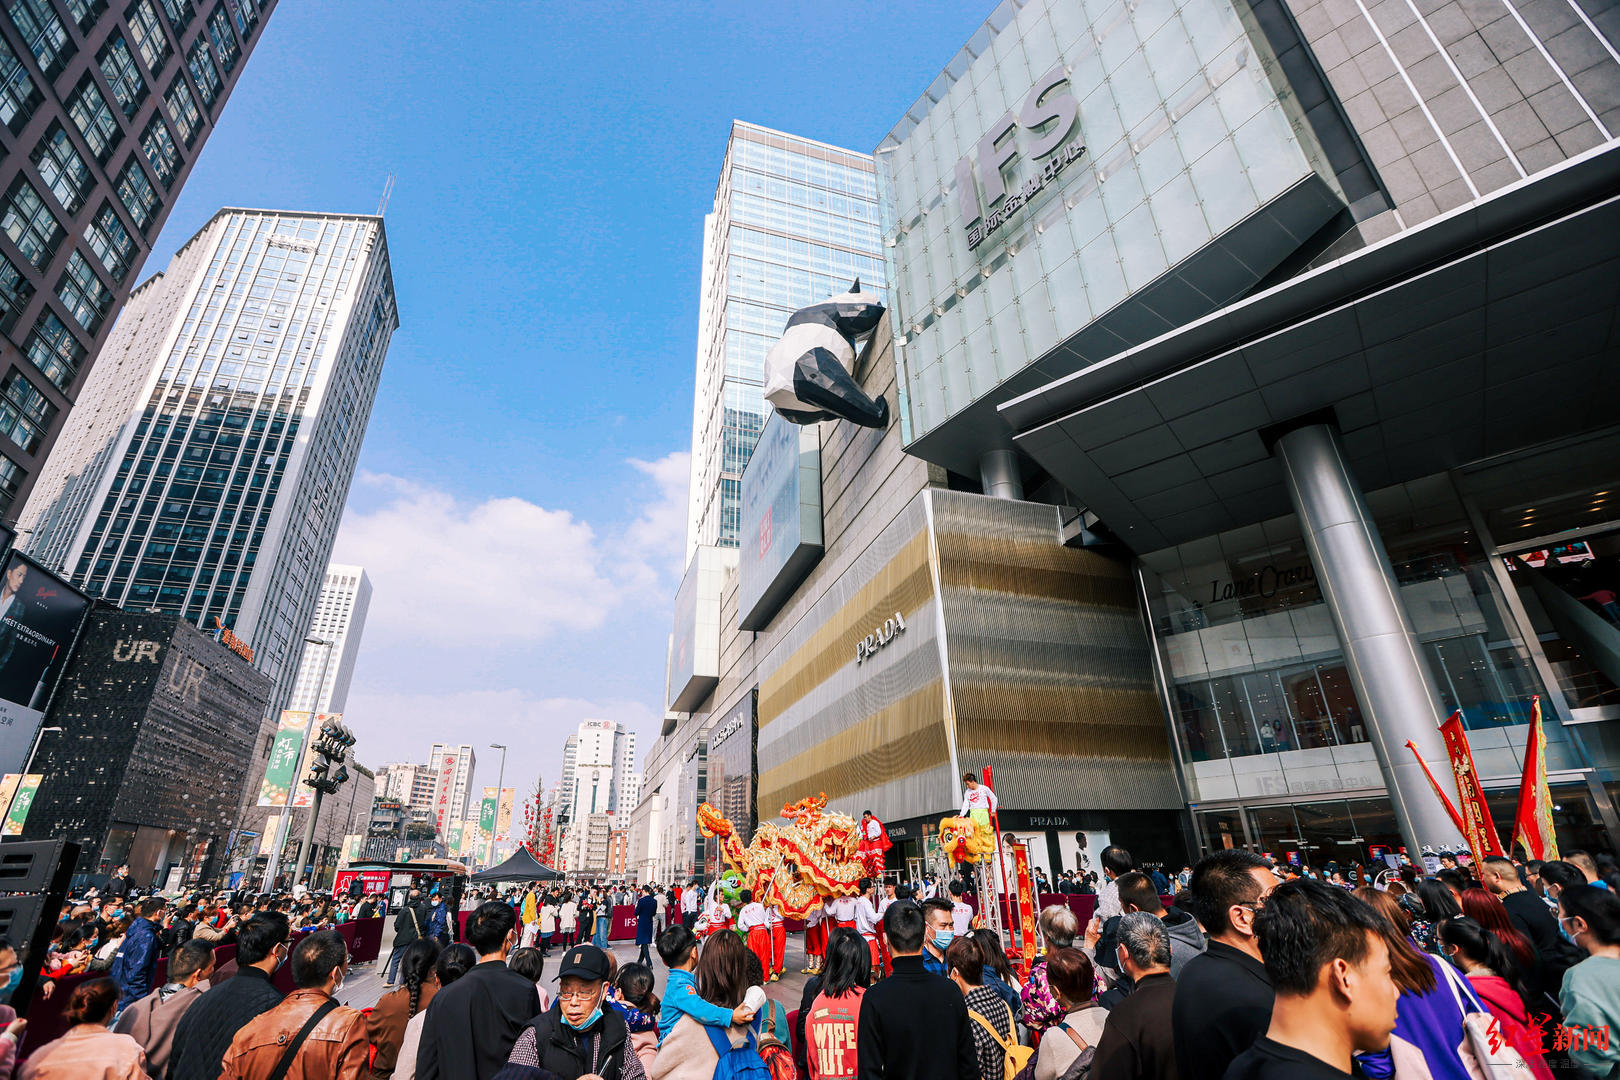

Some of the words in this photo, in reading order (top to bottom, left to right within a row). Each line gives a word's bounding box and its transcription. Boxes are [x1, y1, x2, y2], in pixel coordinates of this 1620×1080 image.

[954, 65, 1079, 230] IFS
[968, 140, 1087, 251] 国际金融中心
[1211, 576, 1254, 603] Lane
[1259, 565, 1315, 598] Craw
[113, 639, 161, 664] UR
[856, 611, 906, 663] PRADA
[169, 650, 207, 705] UR
[277, 738, 296, 767] 灯市
[1256, 775, 1284, 796] IFS
[1030, 816, 1070, 826] PRADA
[624, 918, 637, 927] IFS
[812, 1023, 856, 1049] WIPE
